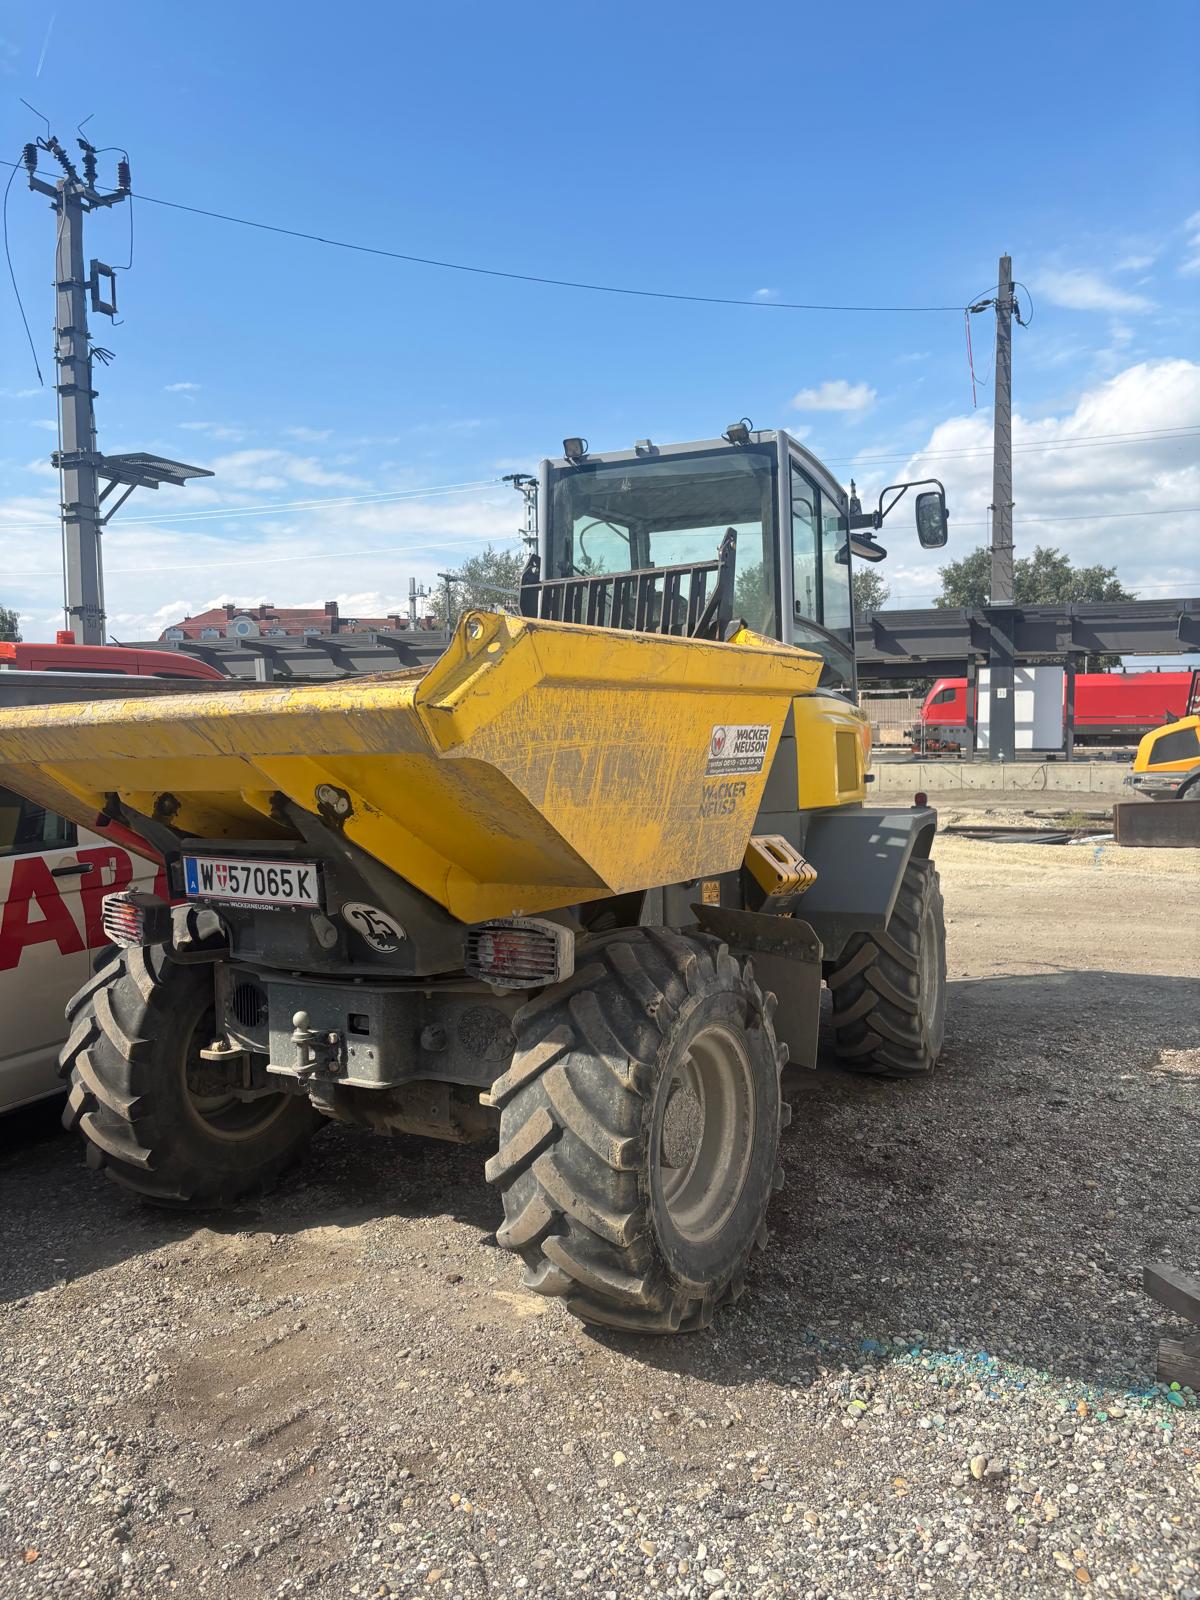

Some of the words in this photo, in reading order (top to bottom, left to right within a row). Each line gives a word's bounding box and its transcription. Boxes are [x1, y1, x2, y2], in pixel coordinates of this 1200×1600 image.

[736, 729, 769, 740] WACKER
[733, 741, 767, 754] NEUSON
[201, 864, 213, 891] W
